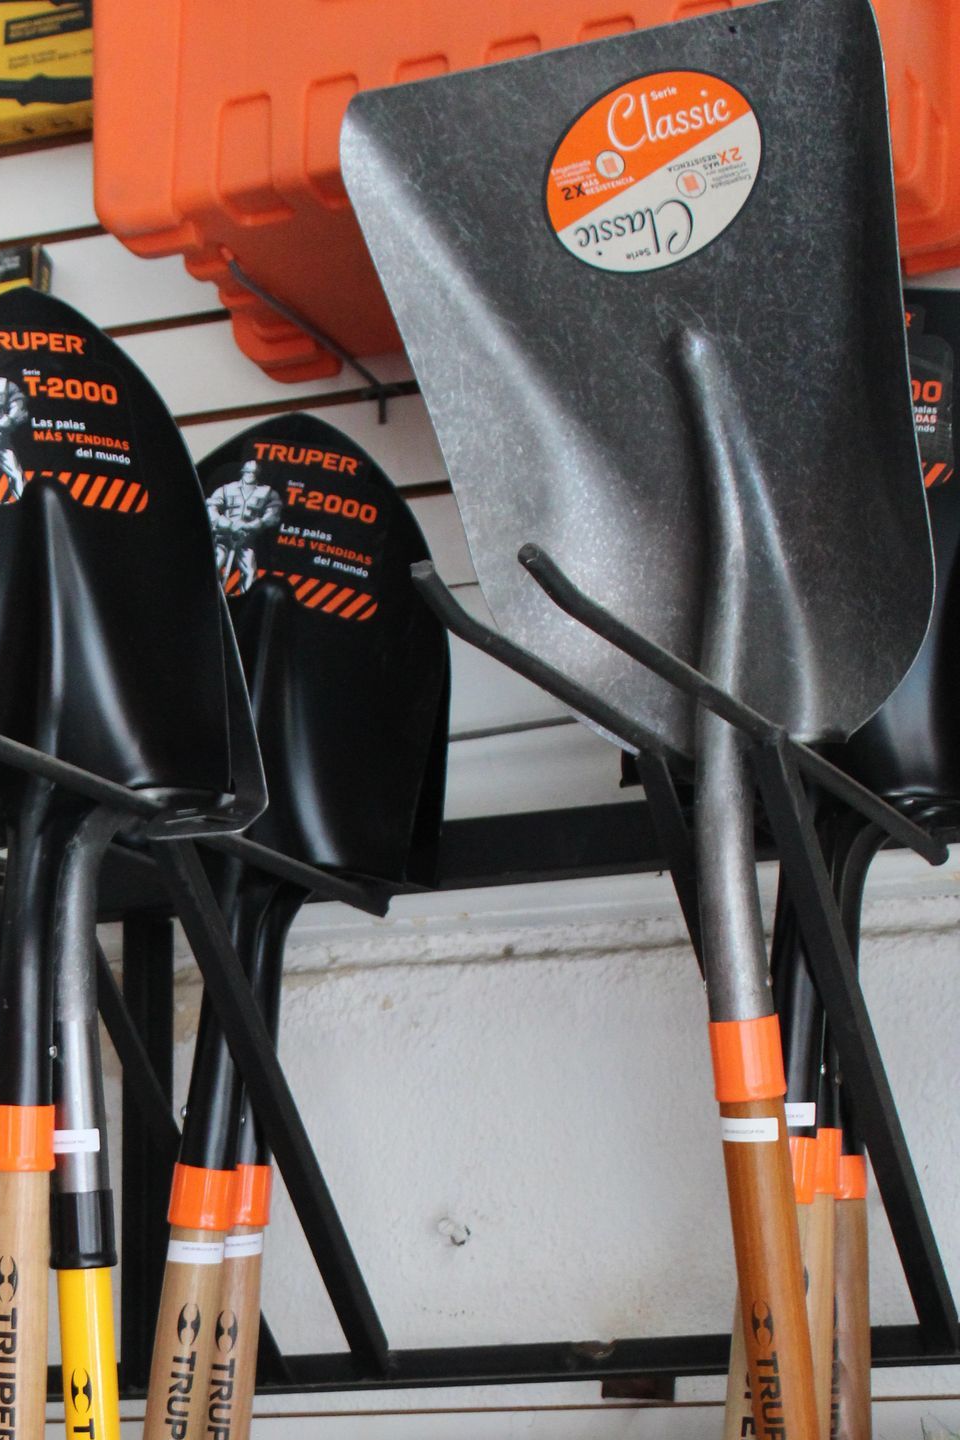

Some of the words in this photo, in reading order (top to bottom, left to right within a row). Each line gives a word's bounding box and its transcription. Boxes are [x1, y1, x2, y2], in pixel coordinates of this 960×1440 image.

[650, 85, 678, 101] Serie
[607, 89, 731, 151] Classic
[719, 147, 743, 166] 2X
[561, 183, 586, 201] 2X
[574, 200, 694, 257] Classic
[626, 247, 651, 261] Serie
[23, 375, 119, 406] T-2000
[32, 417, 53, 429] Las
[56, 418, 86, 431] palas
[33, 430, 63, 442] MÁS
[66, 432, 130, 451] VENDIDAS
[75, 447, 93, 459] del
[96, 451, 131, 465] mundo
[254, 443, 360, 476] TRUPER
[286, 487, 378, 525] T-2000
[280, 523, 300, 535] Las
[303, 528, 333, 542] palas
[277, 535, 306, 548] MÁS
[310, 541, 373, 566] VENDIDAS
[314, 555, 330, 567] del
[333, 560, 369, 578] mundo
